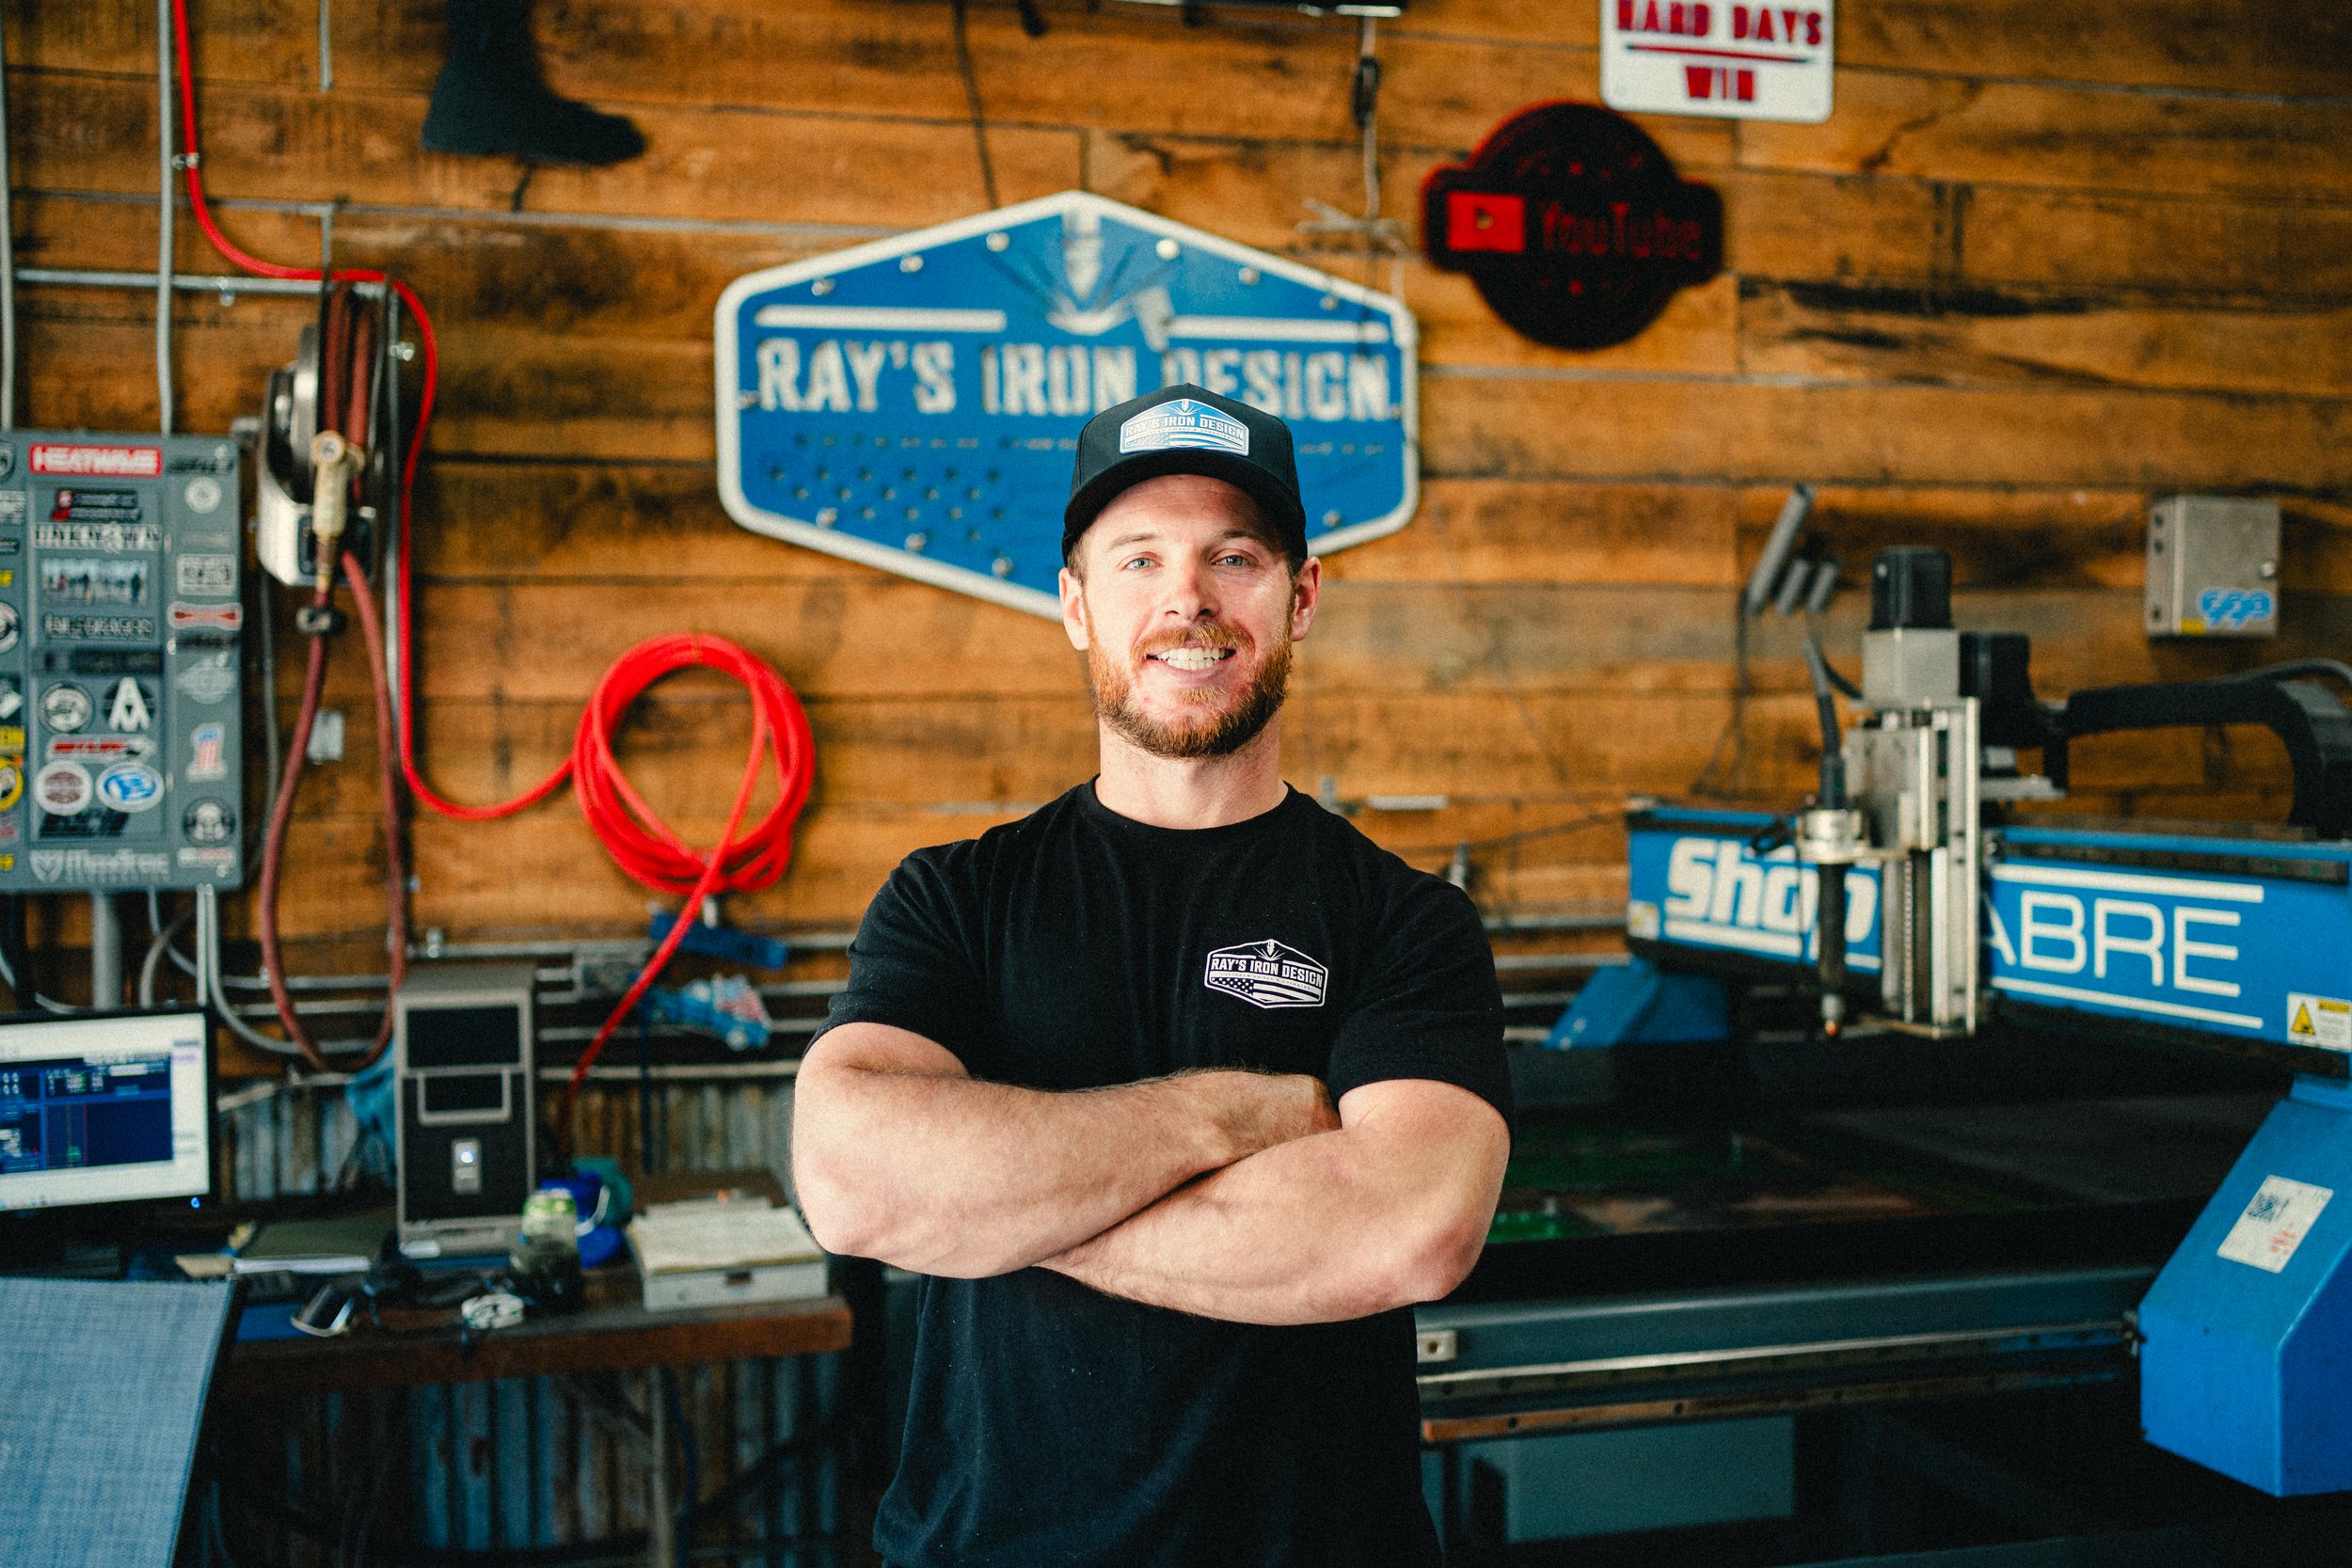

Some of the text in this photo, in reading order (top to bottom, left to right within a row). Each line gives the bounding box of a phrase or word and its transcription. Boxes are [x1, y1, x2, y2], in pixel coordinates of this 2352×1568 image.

[1616, 0, 1821, 45] HARD DAYS
[1685, 67, 1756, 102] WIN
[1538, 200, 1702, 261] YouTube
[756, 337, 1391, 421] RAY'S IRON DESIGN
[1126, 418, 1160, 437] RAY'S
[1164, 416, 1195, 427] IRON
[1200, 419, 1244, 440] DESIGN
[1210, 958, 1323, 988] RAY'S IRON DESIGN
